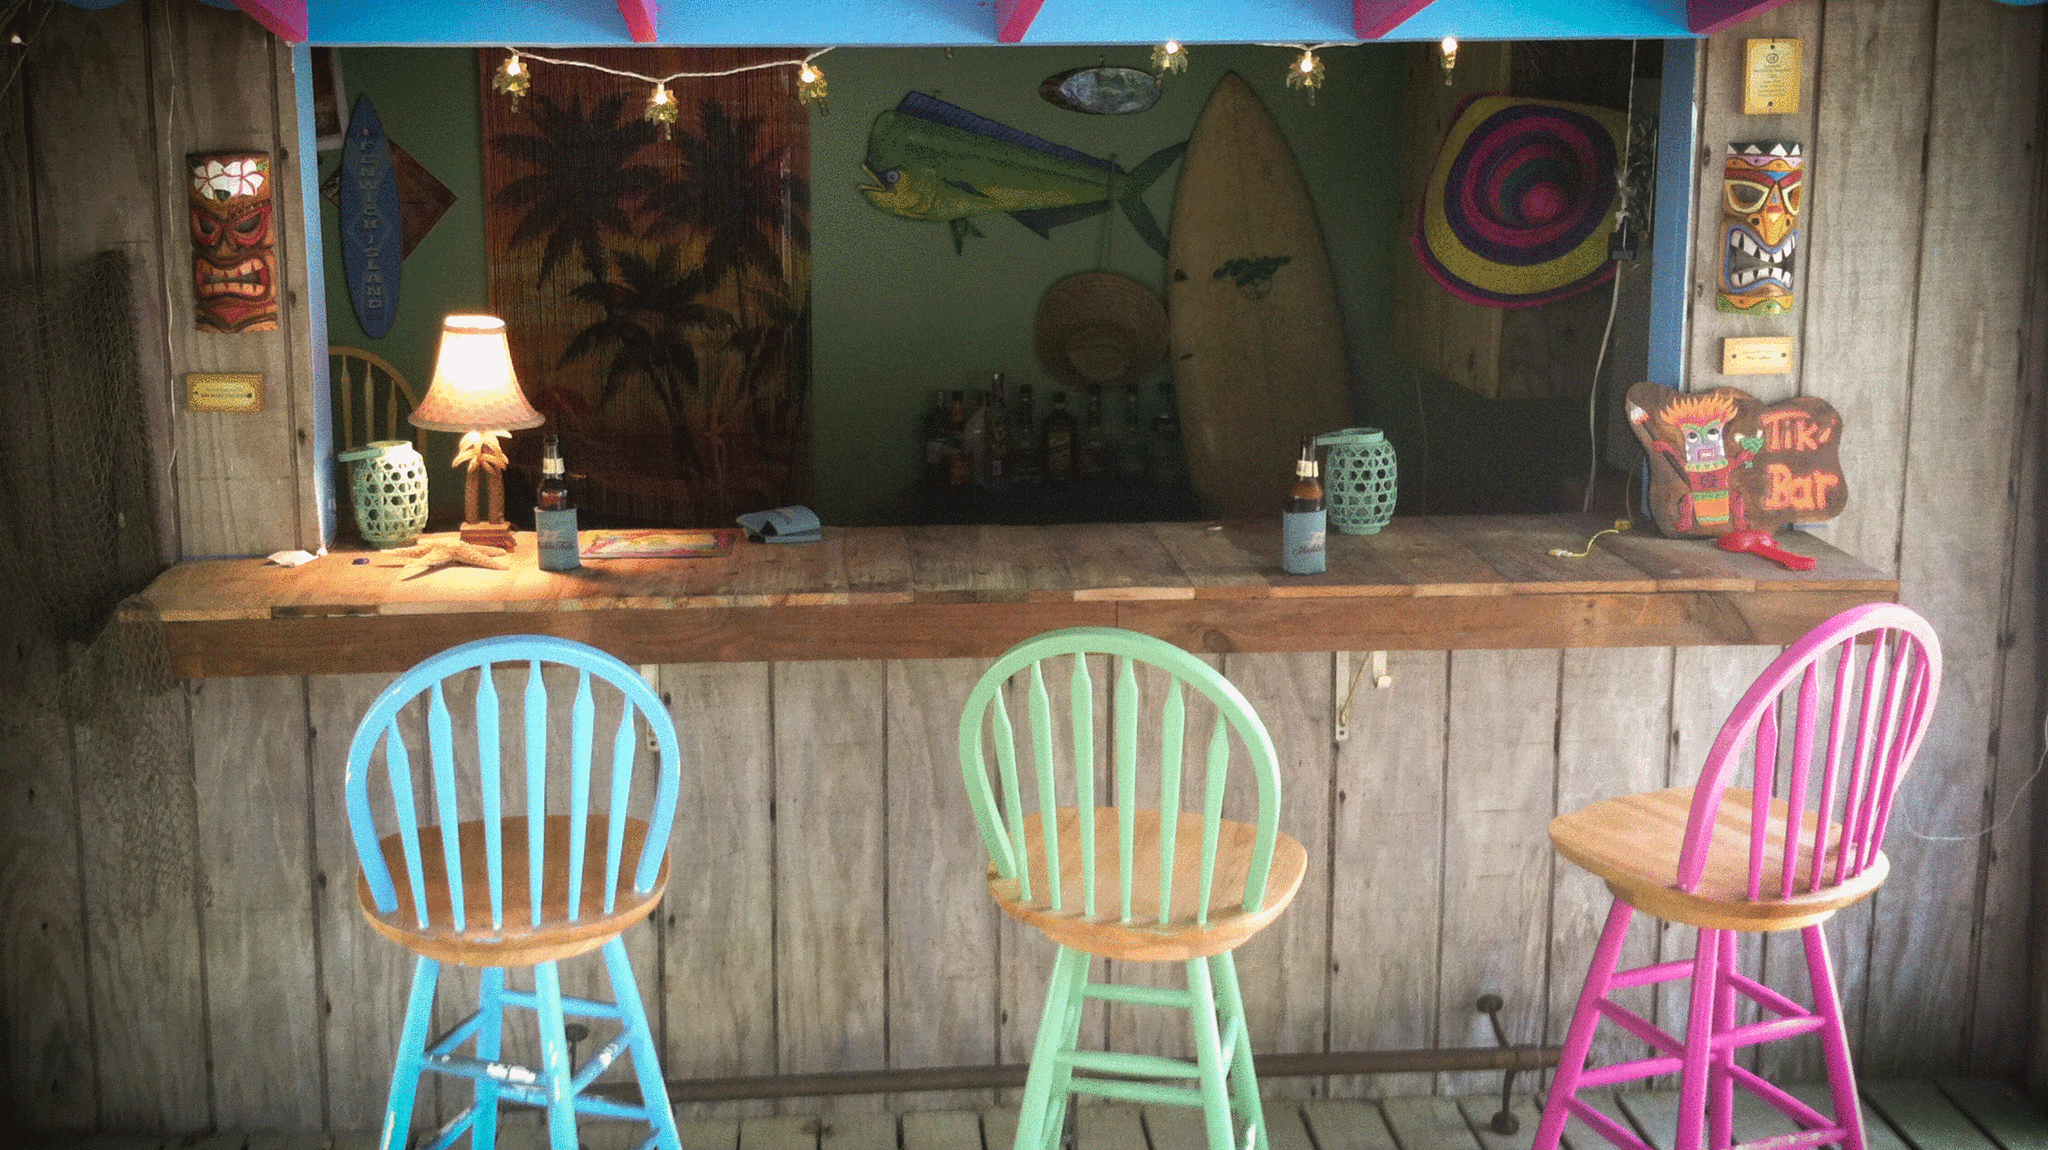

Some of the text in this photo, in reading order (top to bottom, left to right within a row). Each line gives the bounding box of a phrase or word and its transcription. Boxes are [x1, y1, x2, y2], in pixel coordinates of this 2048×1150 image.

[357, 141, 383, 309] FENWICK ISLAND
[1760, 410, 1836, 451] Tiki
[1764, 463, 1839, 511] Bar
